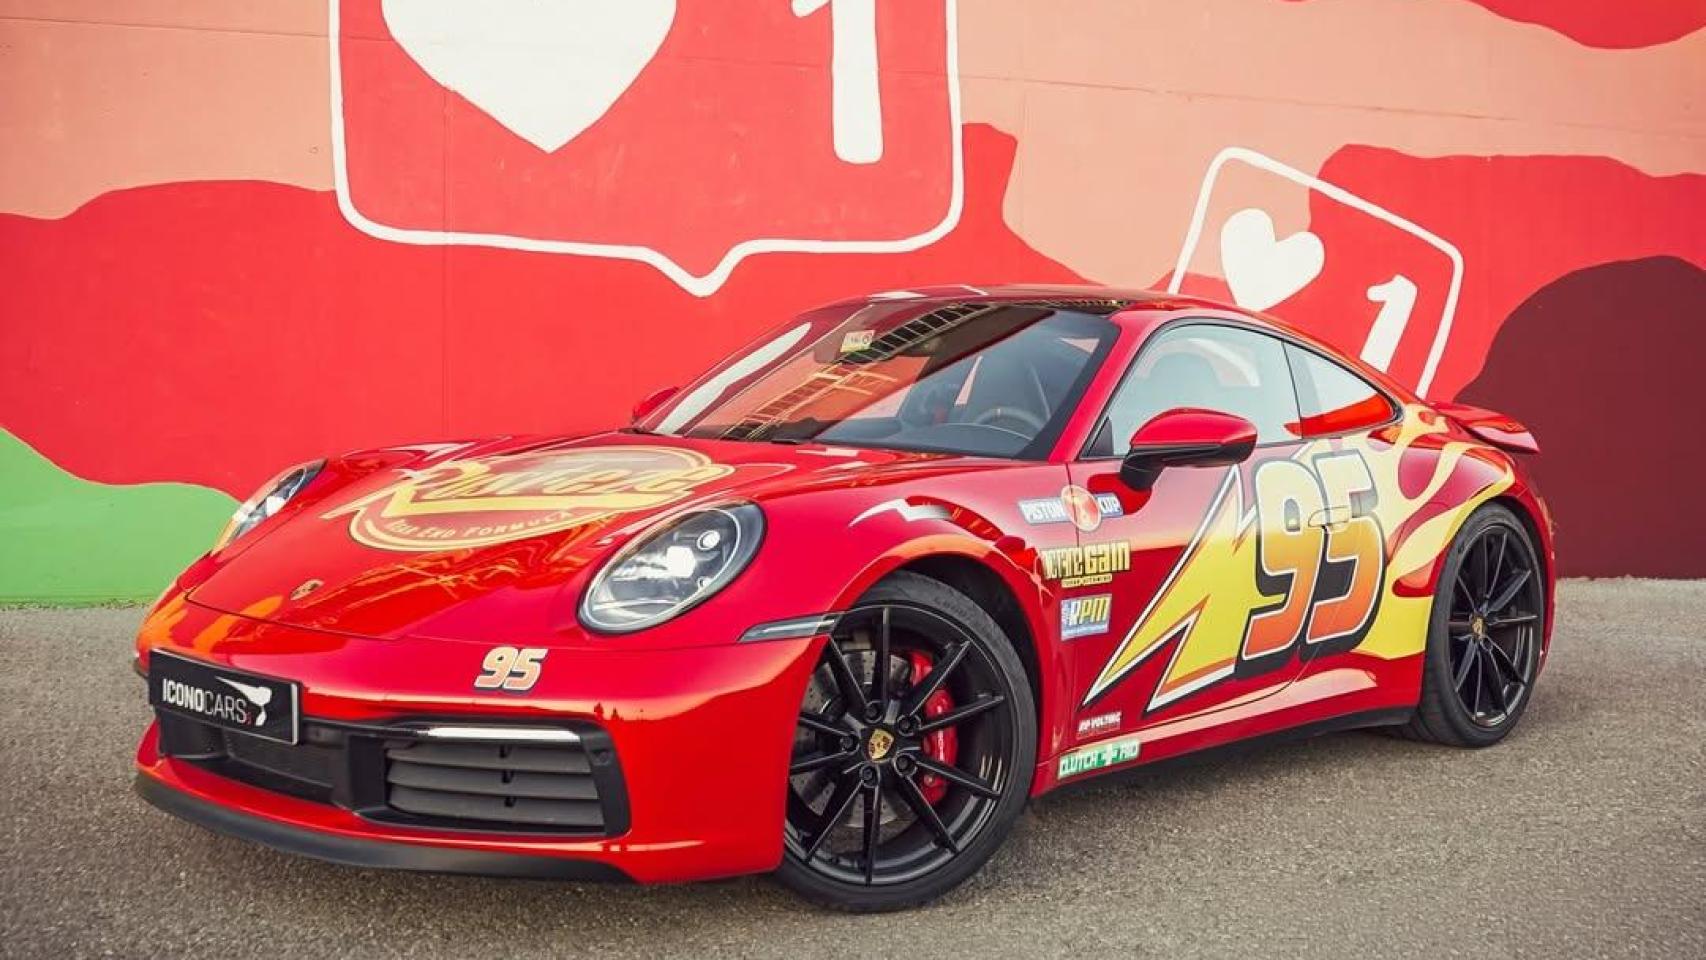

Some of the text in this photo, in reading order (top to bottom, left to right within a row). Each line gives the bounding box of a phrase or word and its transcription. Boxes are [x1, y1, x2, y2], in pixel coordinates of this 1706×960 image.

[790, 0, 884, 164] 1
[1359, 273, 1418, 375] 1
[1241, 451, 1385, 662] 95
[1069, 597, 1110, 625] RPM
[162, 678, 248, 724] ICONOCARS
[473, 646, 549, 691] 95
